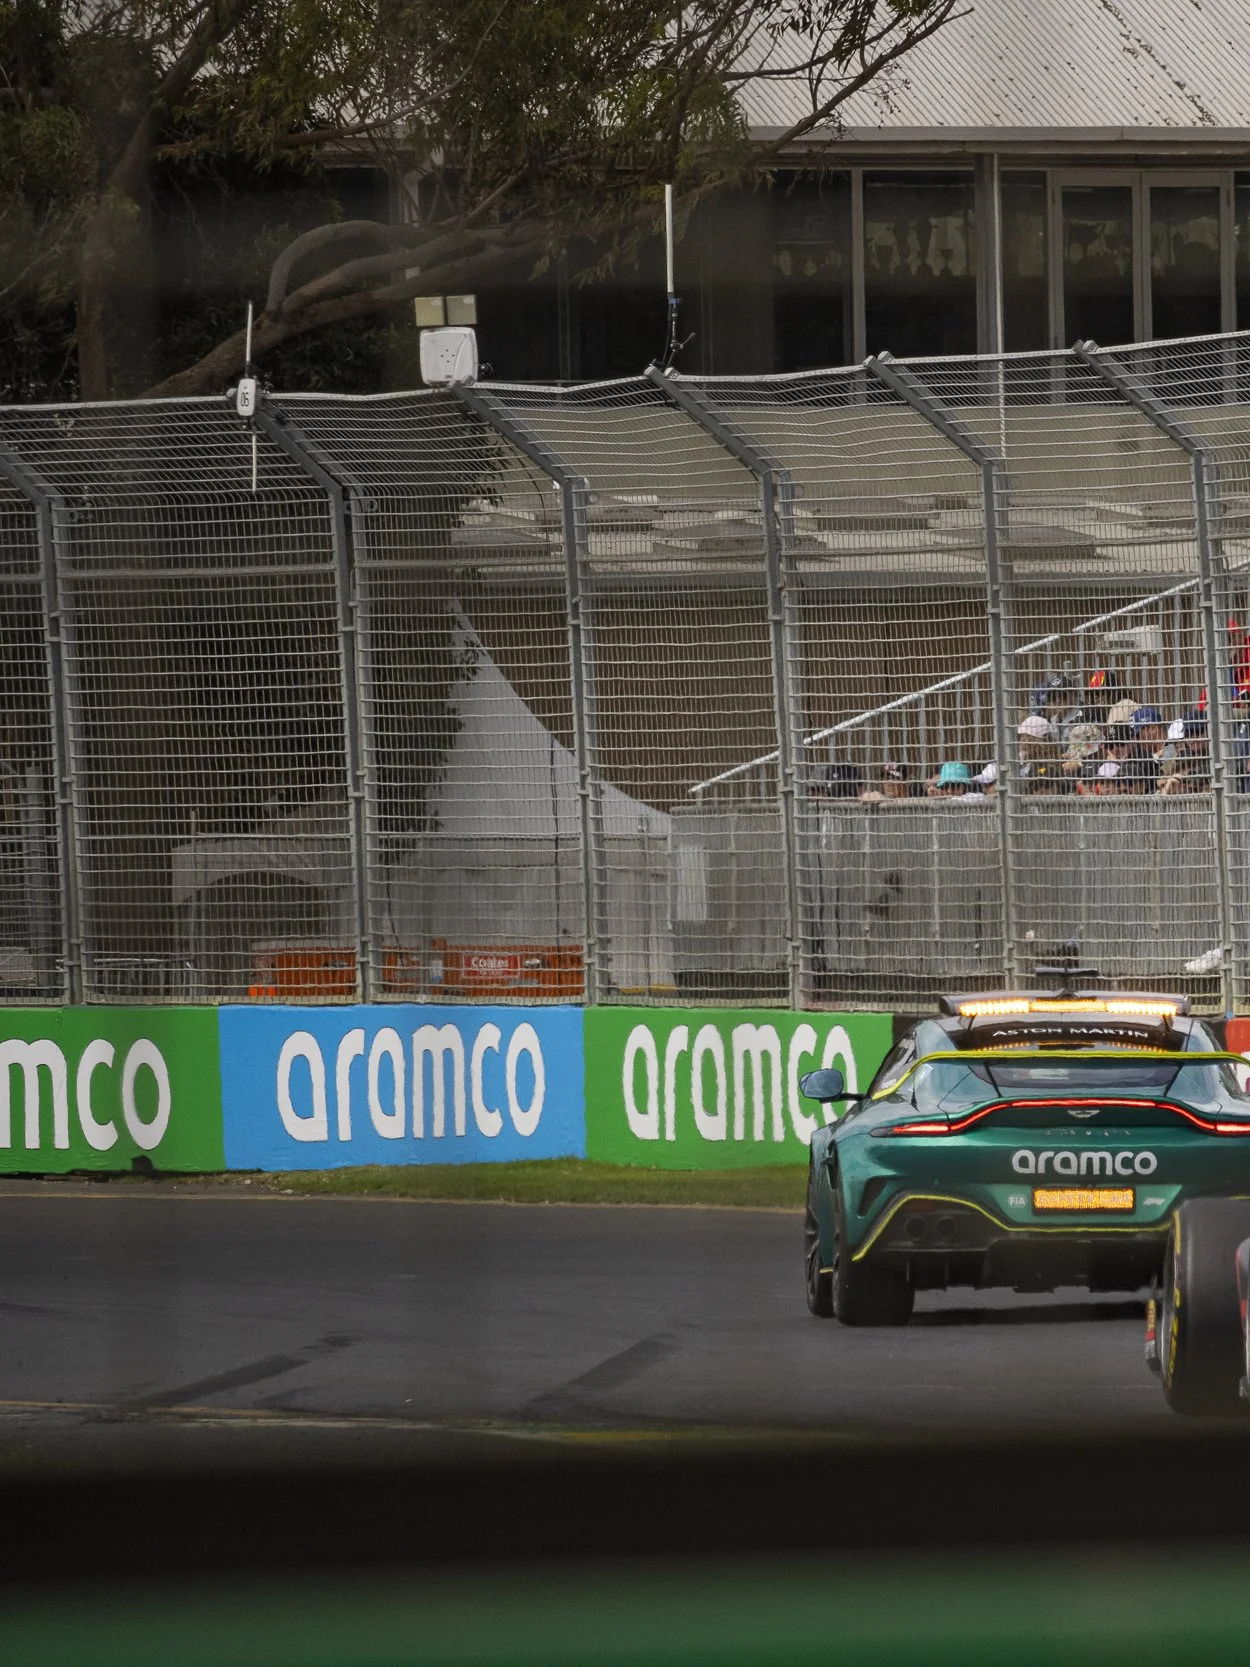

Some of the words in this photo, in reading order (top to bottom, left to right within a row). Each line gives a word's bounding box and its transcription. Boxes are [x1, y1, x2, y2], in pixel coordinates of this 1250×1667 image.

[992, 1027, 1062, 1037] ASTON
[1069, 1027, 1149, 1039] MARTIN
[276, 1021, 545, 1142] aramco
[622, 1023, 859, 1147] aramco
[1011, 1149, 1158, 1176] aramco
